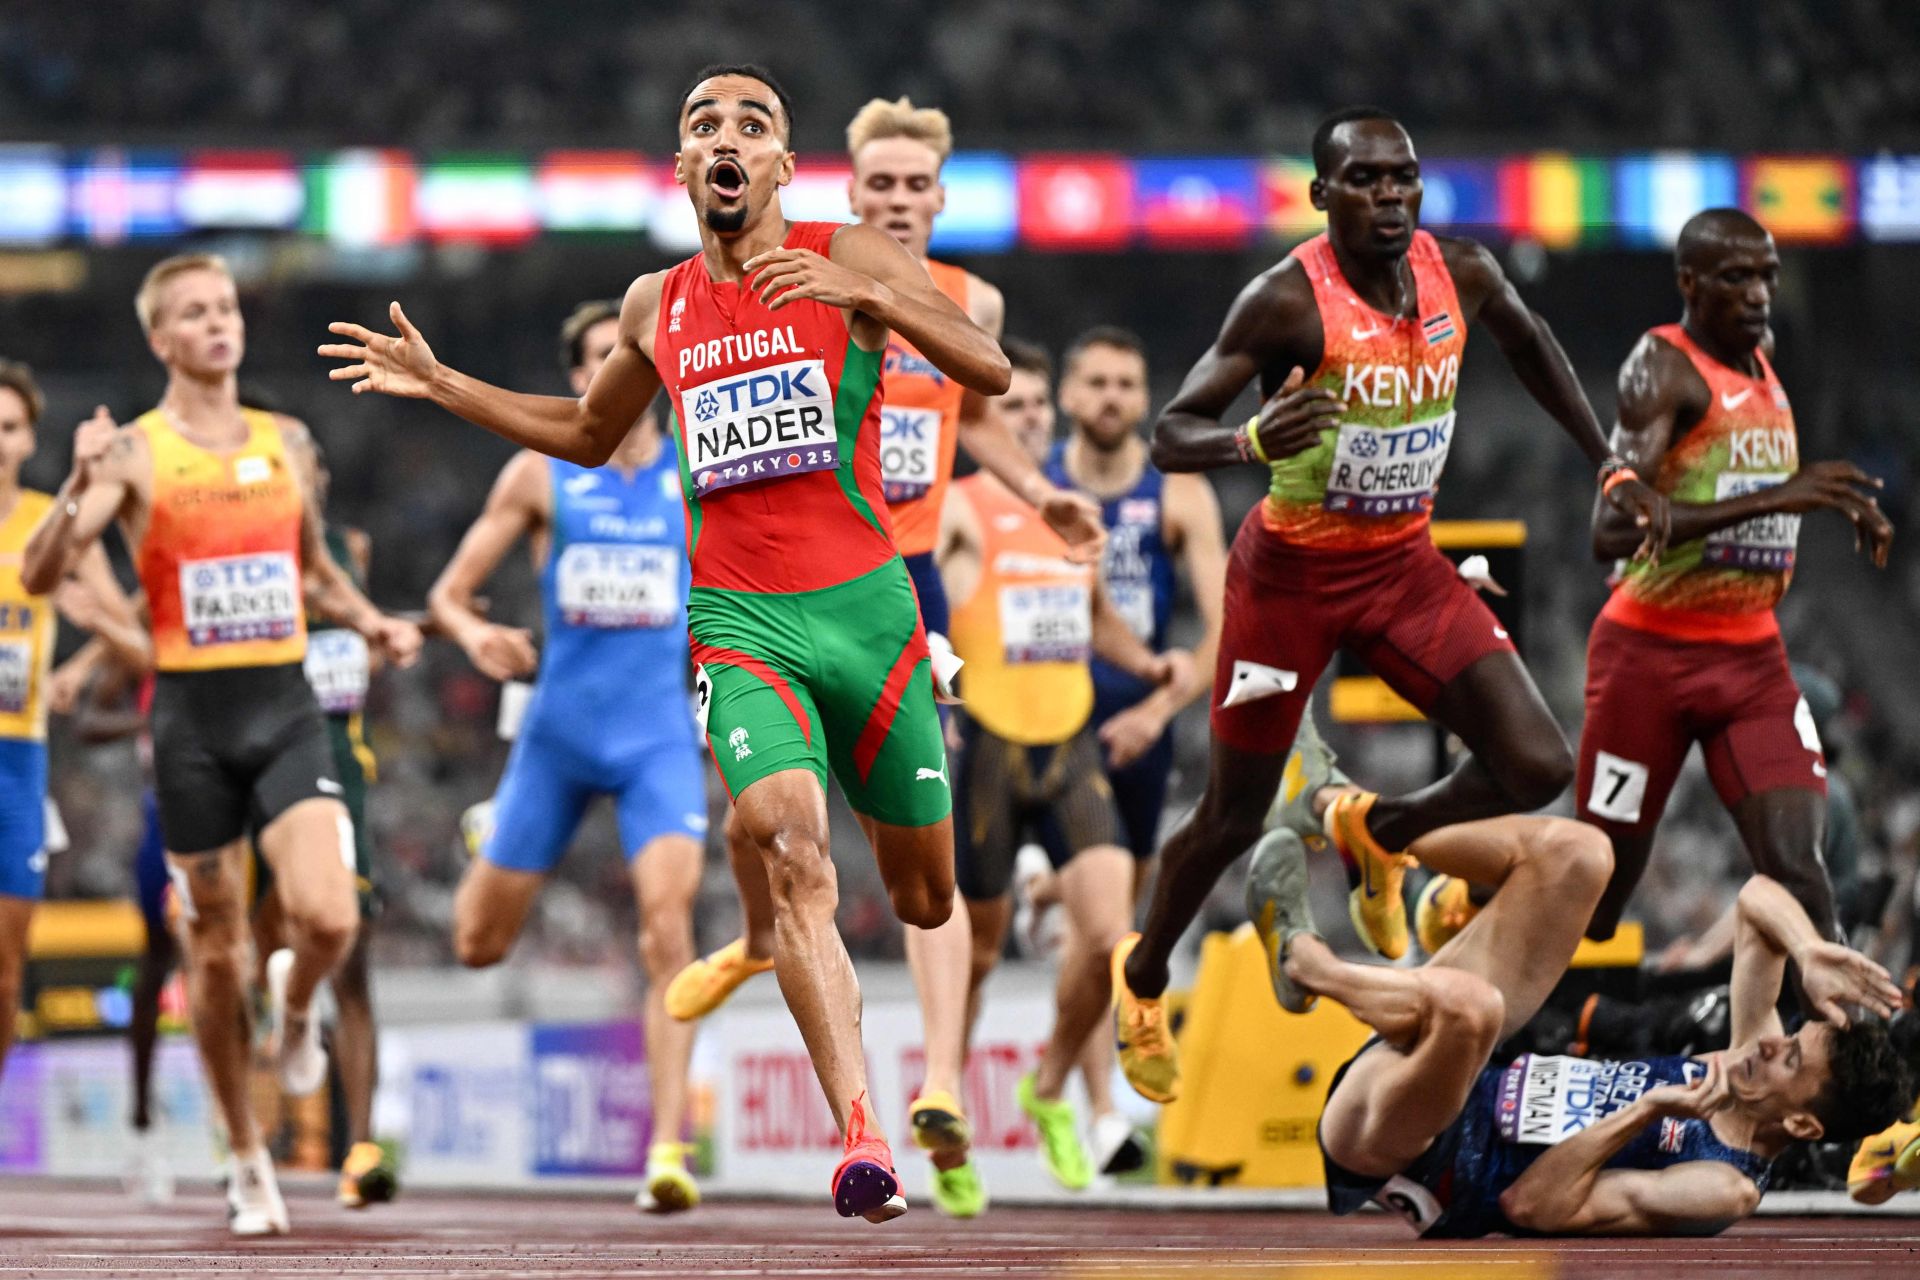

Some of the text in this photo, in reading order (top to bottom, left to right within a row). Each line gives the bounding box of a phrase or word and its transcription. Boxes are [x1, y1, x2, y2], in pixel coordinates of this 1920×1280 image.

[679, 325, 805, 379] PORTUGAL
[717, 366, 818, 414] TDK
[1342, 354, 1459, 407] KENYA
[696, 405, 826, 463] NADER
[806, 449, 833, 464] 25
[1381, 416, 1448, 457] TDK
[1334, 463, 1353, 489] R.
[1604, 766, 1630, 807] 7
[1562, 1076, 1597, 1133] TDK
